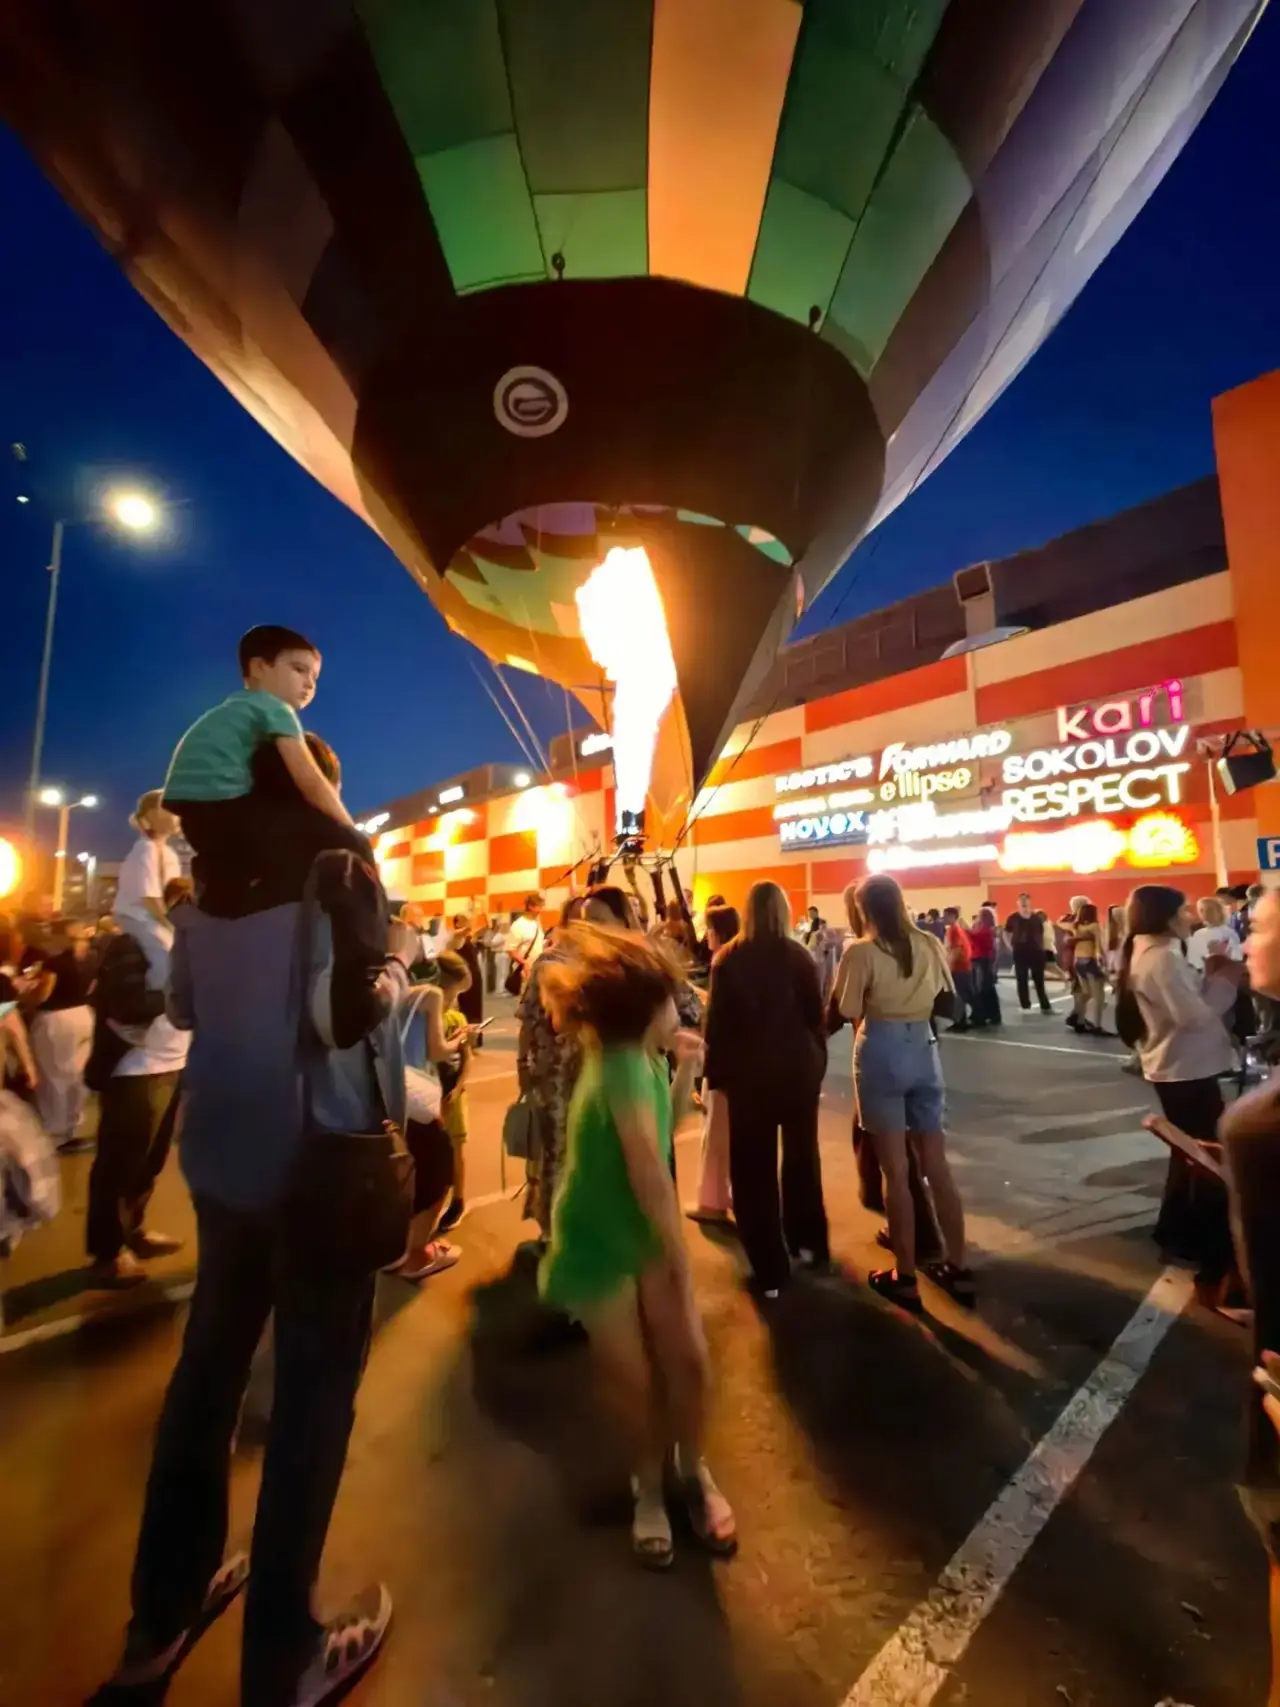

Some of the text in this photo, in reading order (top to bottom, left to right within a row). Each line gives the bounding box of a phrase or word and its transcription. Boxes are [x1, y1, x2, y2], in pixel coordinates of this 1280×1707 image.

[1056, 679, 1183, 742] kari
[1002, 725, 1189, 784] SOKOLOV
[1001, 763, 1191, 823] RESPECT
